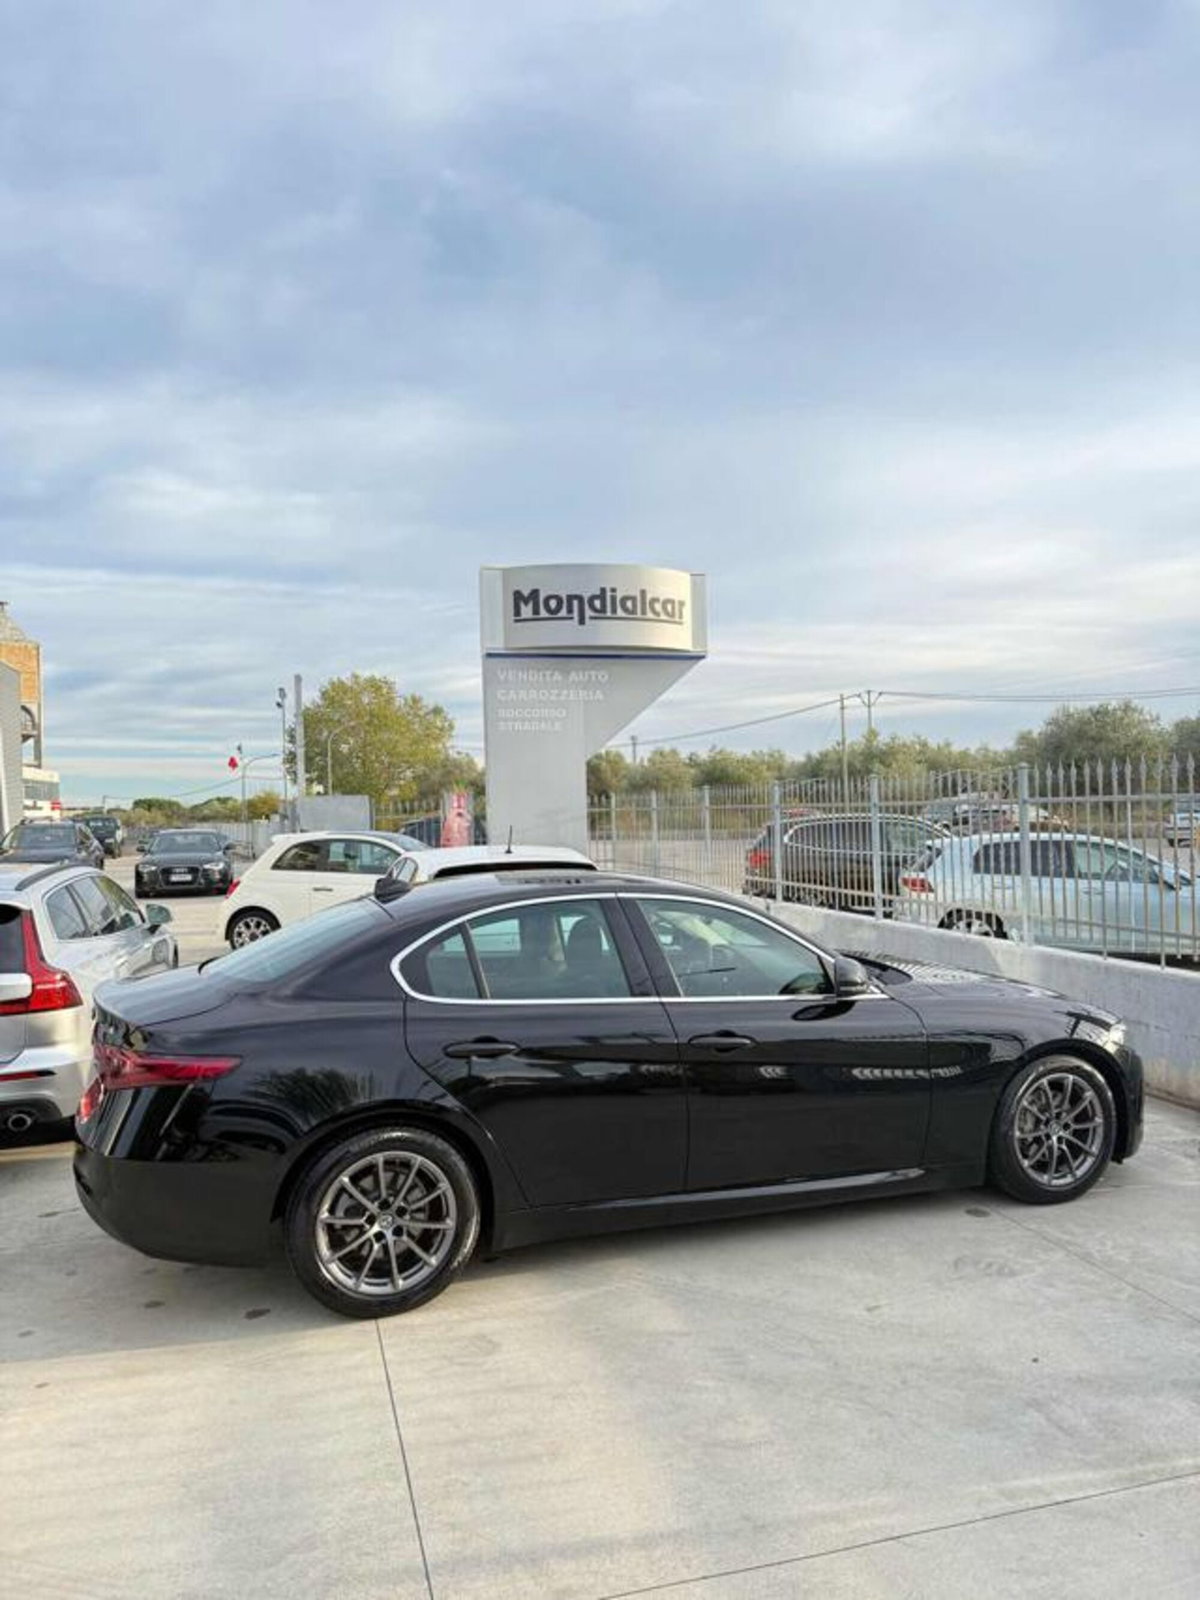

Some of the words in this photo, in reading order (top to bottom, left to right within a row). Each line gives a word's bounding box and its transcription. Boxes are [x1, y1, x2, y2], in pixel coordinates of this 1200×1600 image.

[512, 587, 686, 625] Mondialcar
[497, 669, 562, 681] VENDITA
[568, 670, 609, 682] AUTO
[496, 689, 604, 701] CARROZZERIA
